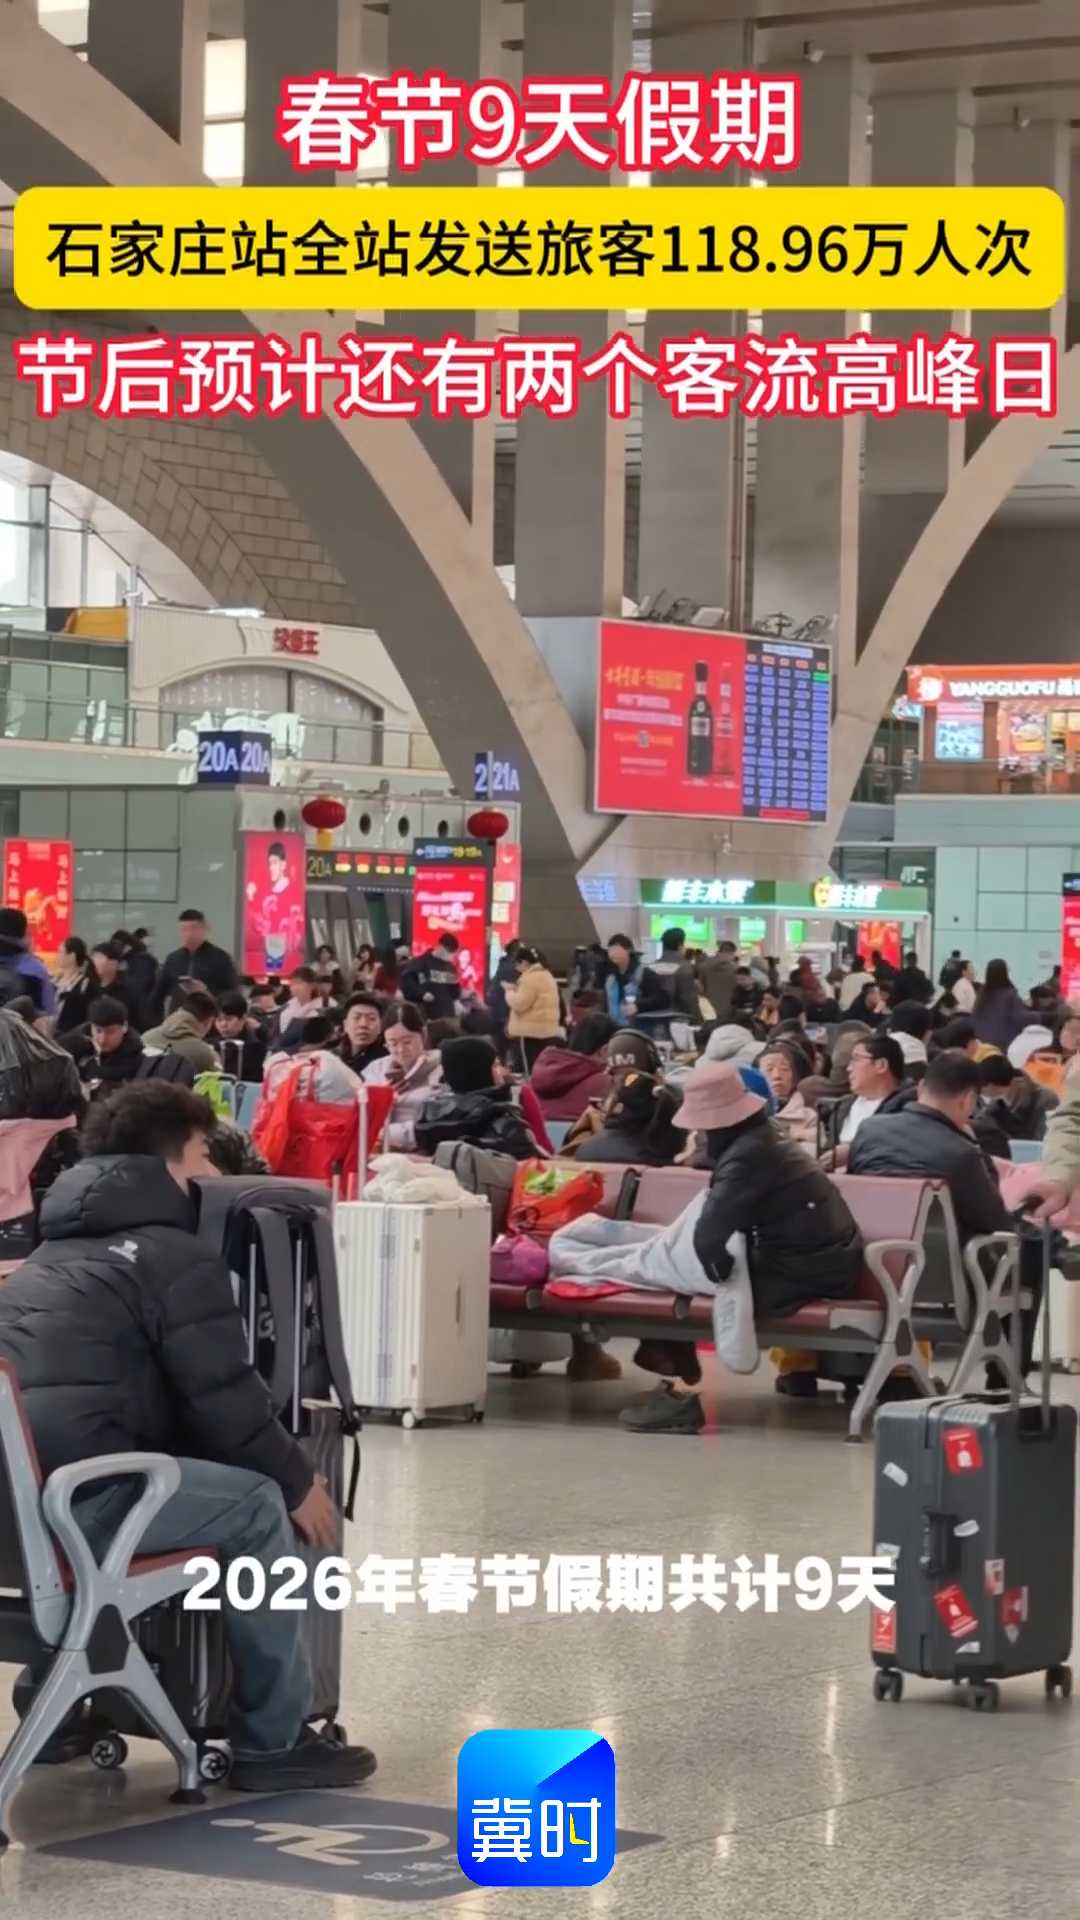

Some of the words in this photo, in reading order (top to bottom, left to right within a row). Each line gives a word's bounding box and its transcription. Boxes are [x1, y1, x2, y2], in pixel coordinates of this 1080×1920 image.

[950, 680, 1057, 698] YANGGUOFU
[199, 740, 240, 772] 20A
[241, 740, 271, 774] 20A
[493, 761, 520, 791] 21A
[307, 856, 333, 878] 20A
